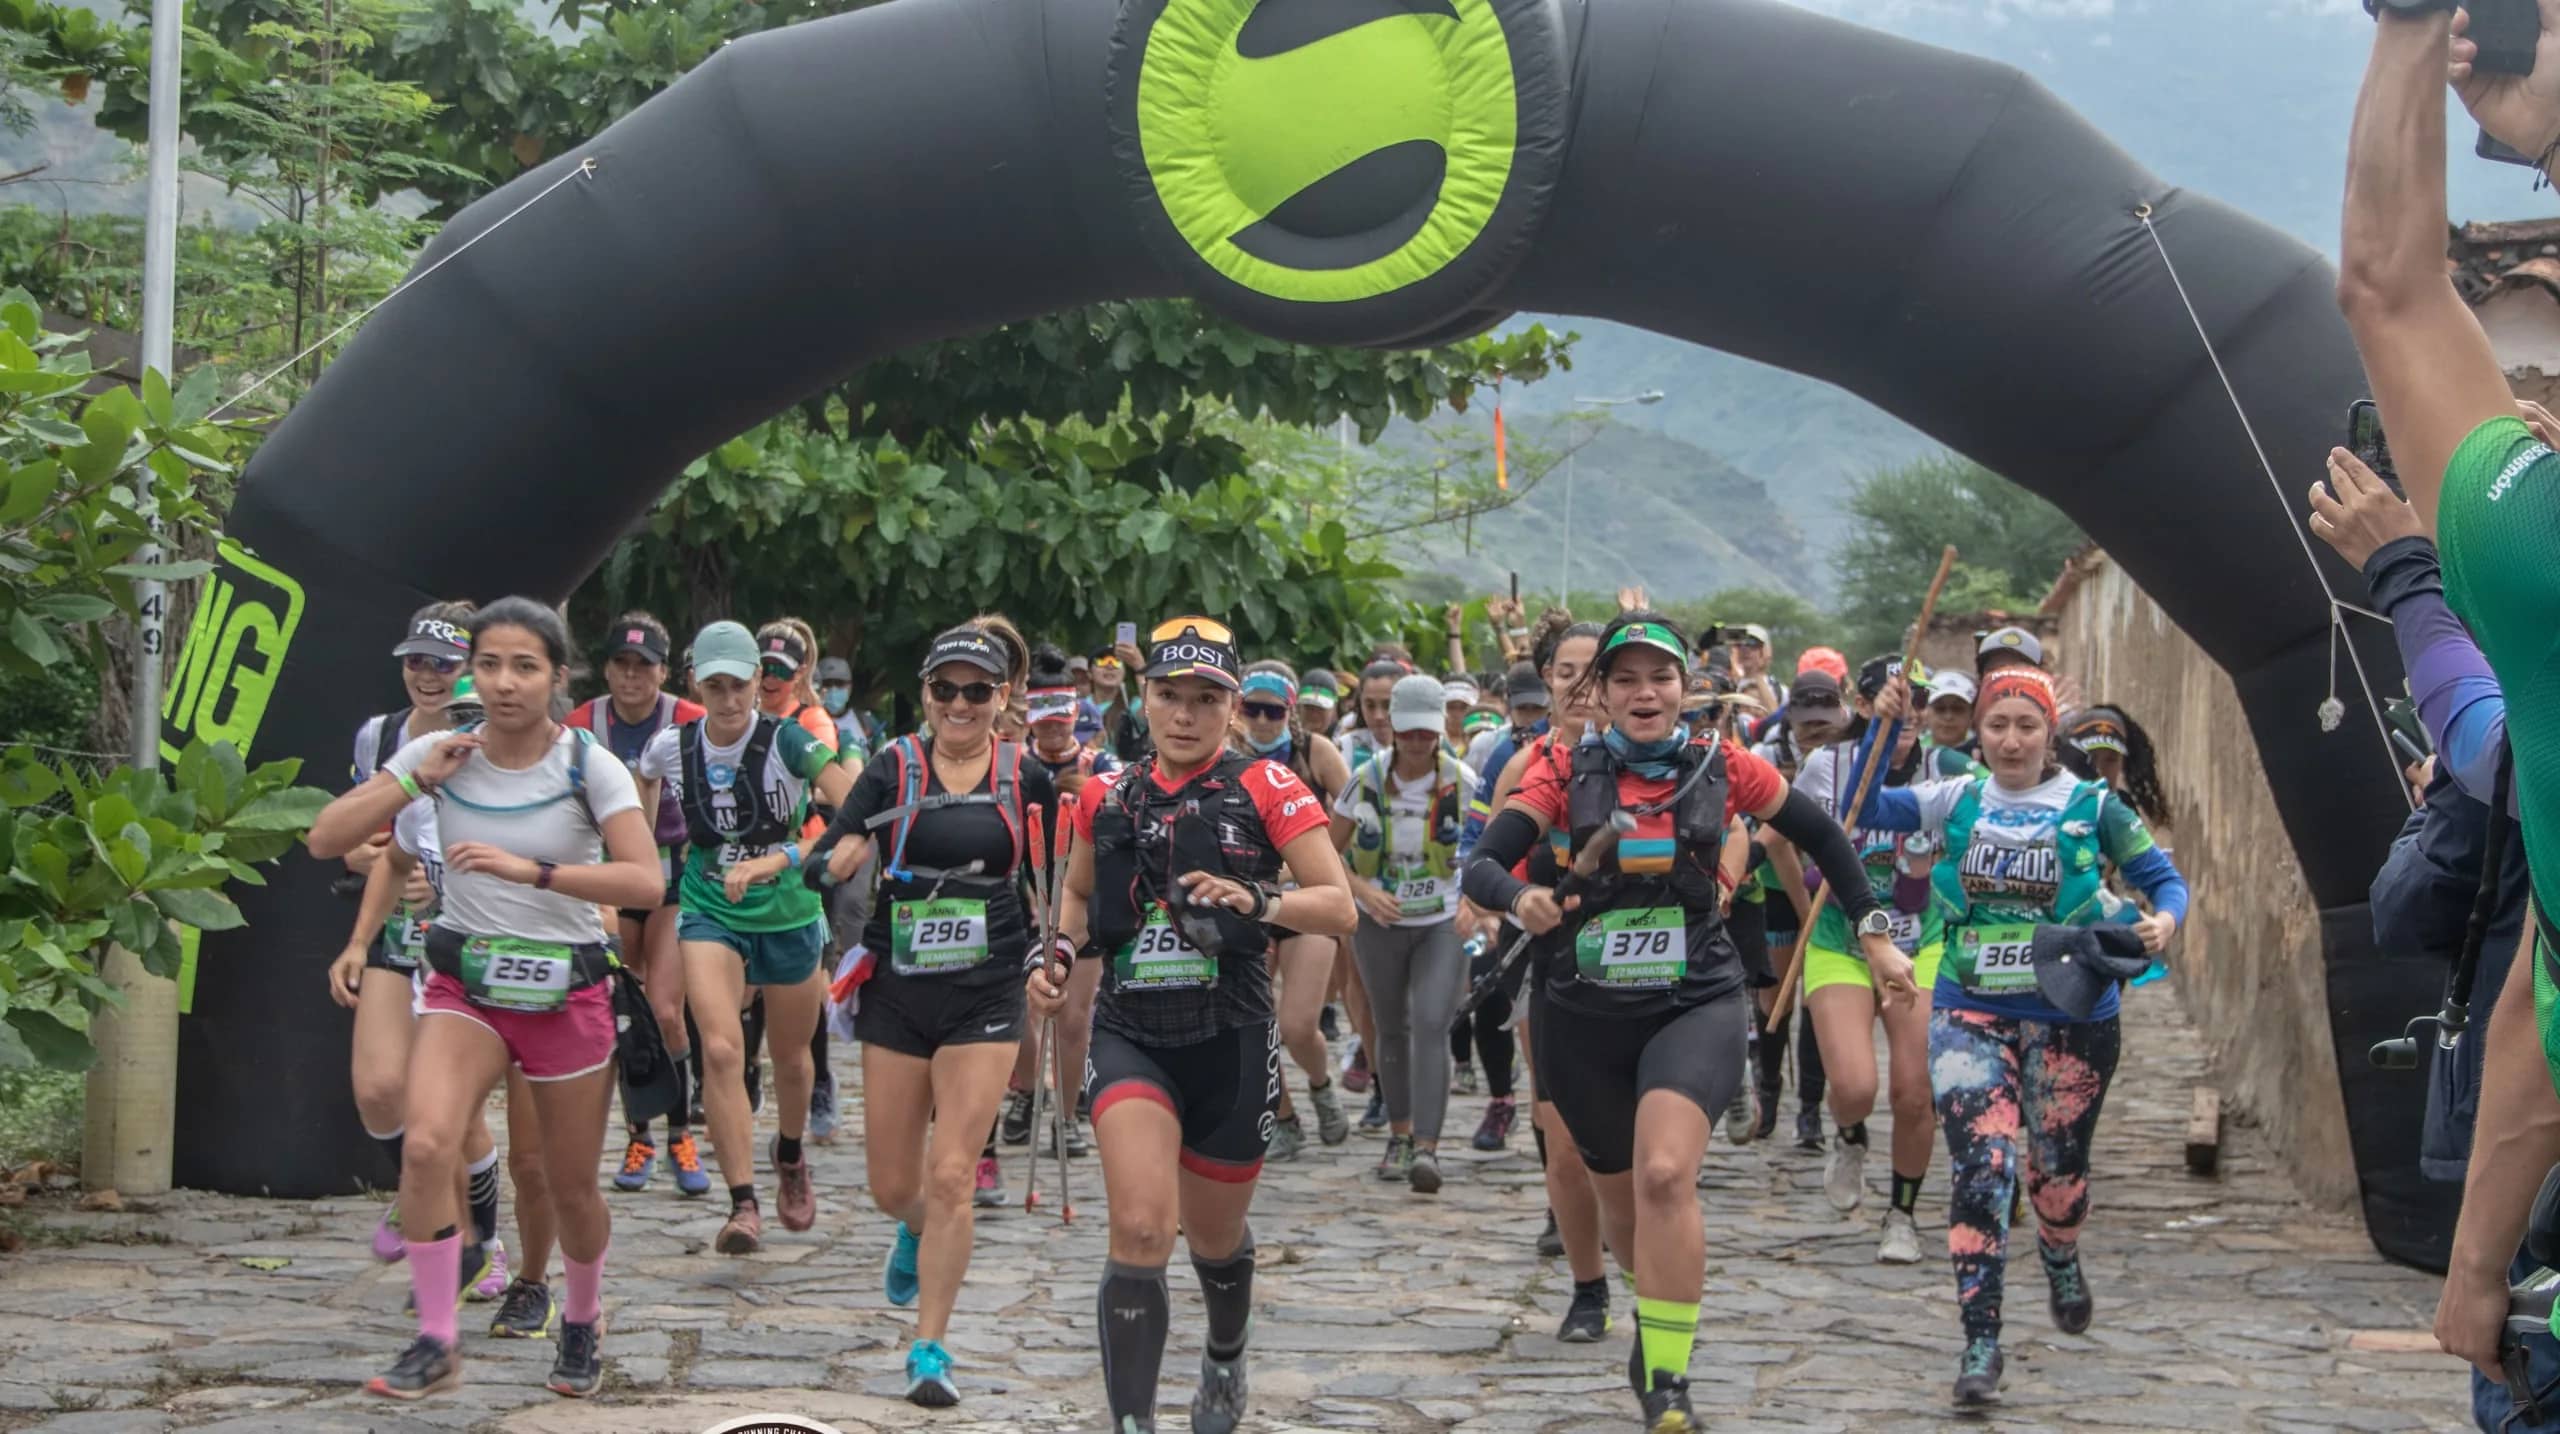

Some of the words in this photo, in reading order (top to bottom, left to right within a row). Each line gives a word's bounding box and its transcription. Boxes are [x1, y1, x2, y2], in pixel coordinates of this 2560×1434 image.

[1162, 644, 1224, 668] BOSI
[919, 919, 971, 945] 296
[1612, 930, 1671, 957] 370
[494, 956, 552, 983] 256
[1265, 1019, 1281, 1104] BOS
